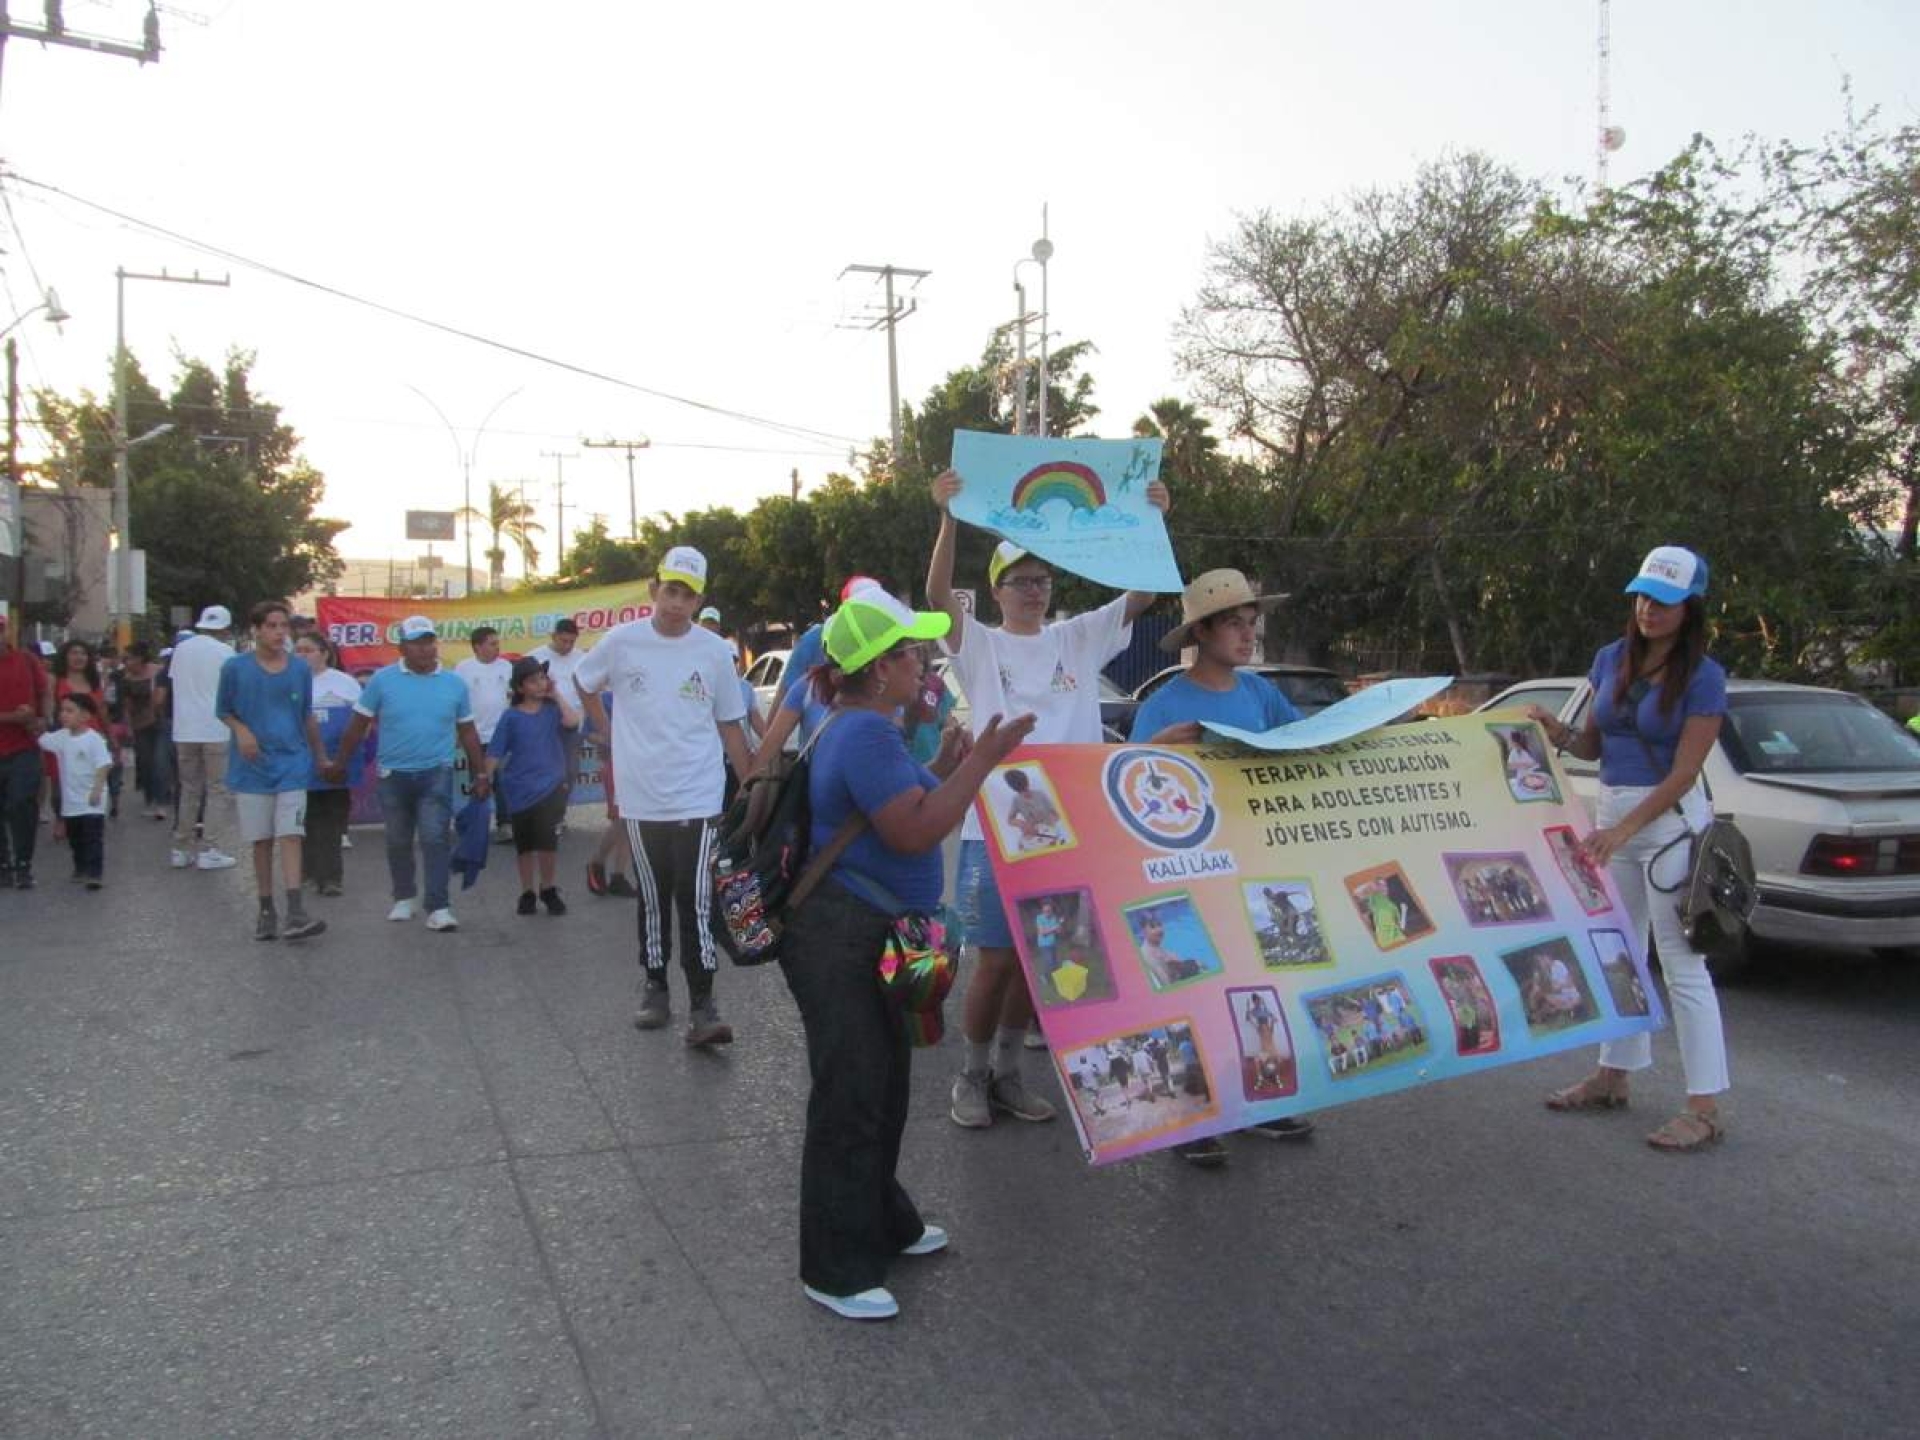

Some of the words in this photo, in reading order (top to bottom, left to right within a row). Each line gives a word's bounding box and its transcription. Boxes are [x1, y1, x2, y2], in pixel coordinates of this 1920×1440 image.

[1241, 762, 1329, 786] TERAPIA
[1331, 761, 1344, 777] Y
[1347, 750, 1450, 776] EDUCACIÓN
[1247, 794, 1306, 816] PARA
[1311, 781, 1449, 809] ADOLESCENTES
[1452, 781, 1462, 798] Y
[1265, 819, 1353, 847] JÓVENES
[1356, 815, 1395, 838] CON
[1400, 810, 1478, 833] AUTISMO.
